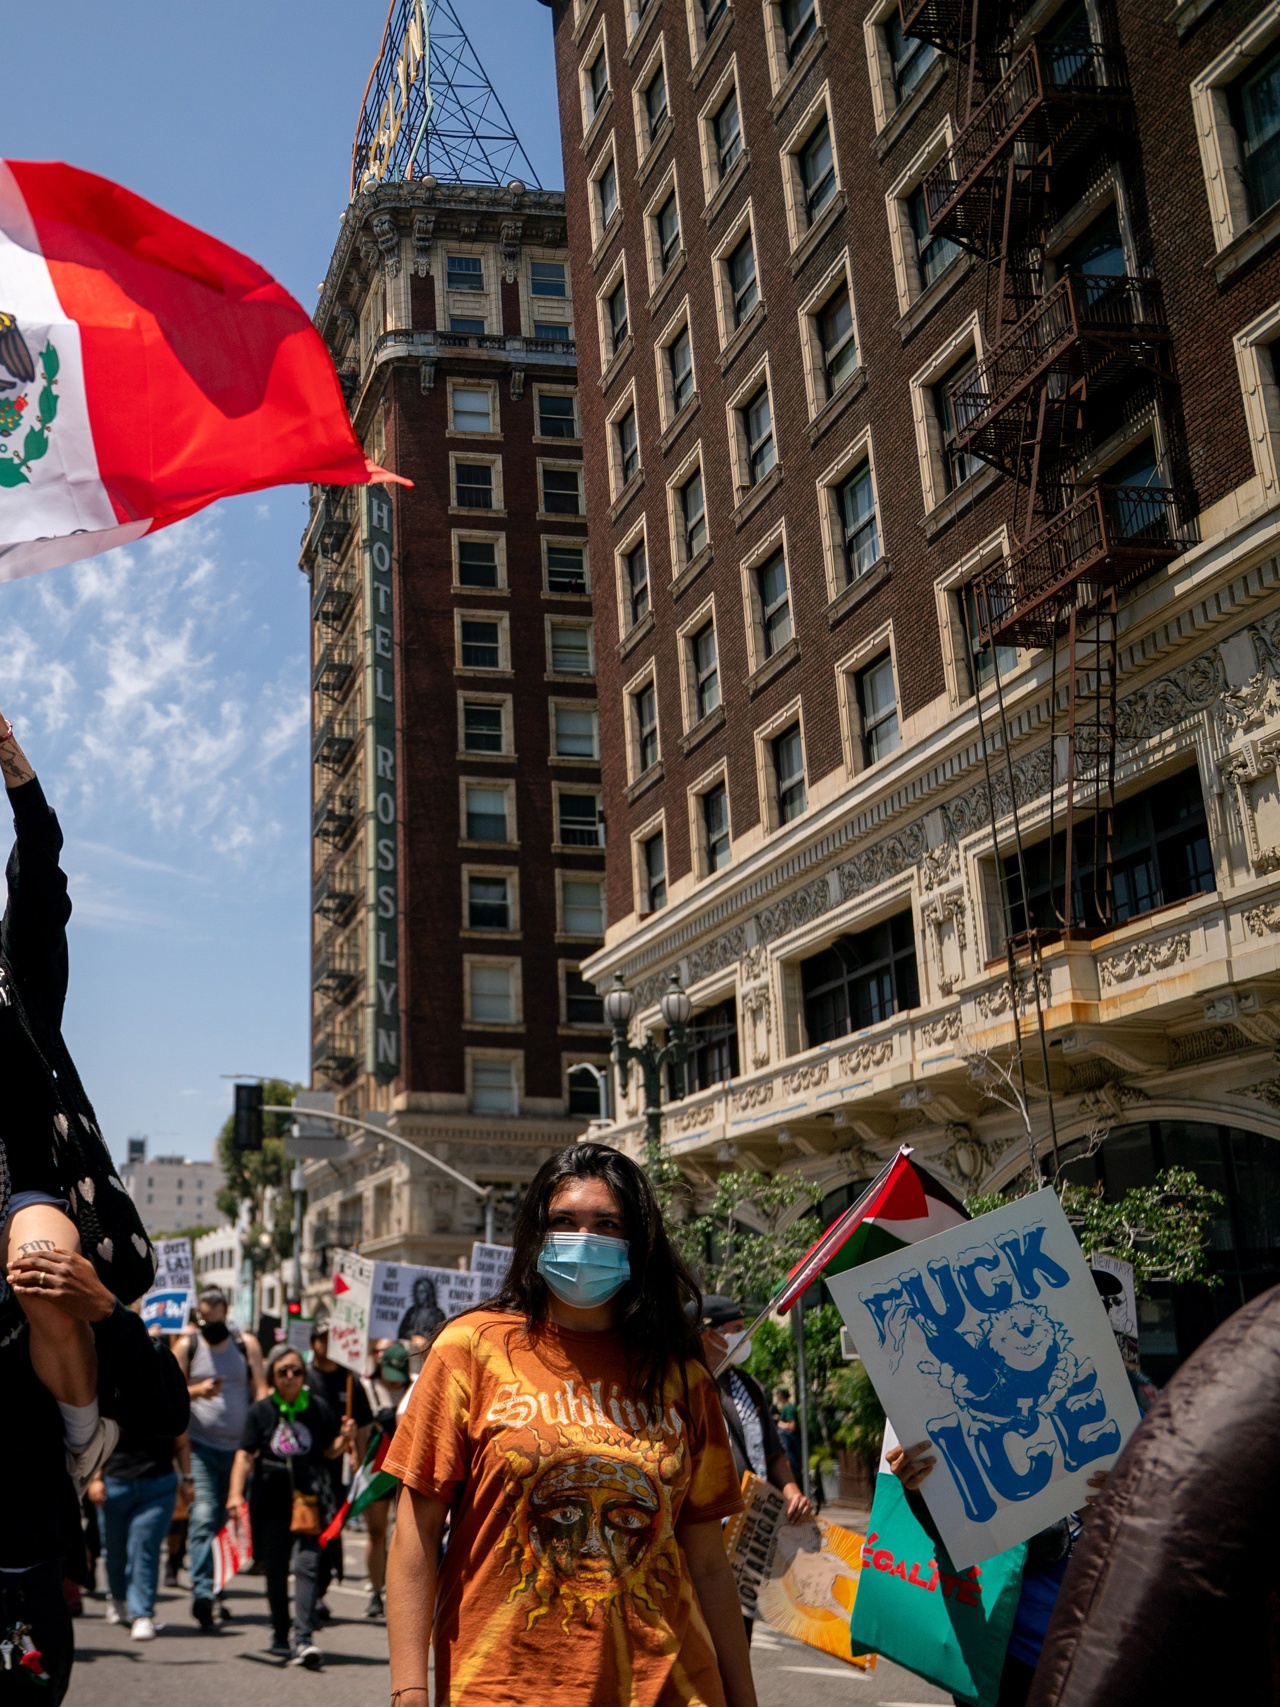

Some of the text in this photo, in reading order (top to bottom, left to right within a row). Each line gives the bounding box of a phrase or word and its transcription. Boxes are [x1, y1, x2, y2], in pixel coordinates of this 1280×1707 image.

[370, 496, 398, 1067] HOTEL ROSSLYN
[382, 1280, 400, 1293] NOT
[434, 1273, 475, 1288] FOR THEY
[448, 1289, 474, 1301] KNOW
[858, 1218, 1071, 1349] FUCK
[375, 1308, 400, 1322] THEM
[926, 1356, 1121, 1523] ICE
[862, 1531, 983, 1607] ÉGALITÉ
